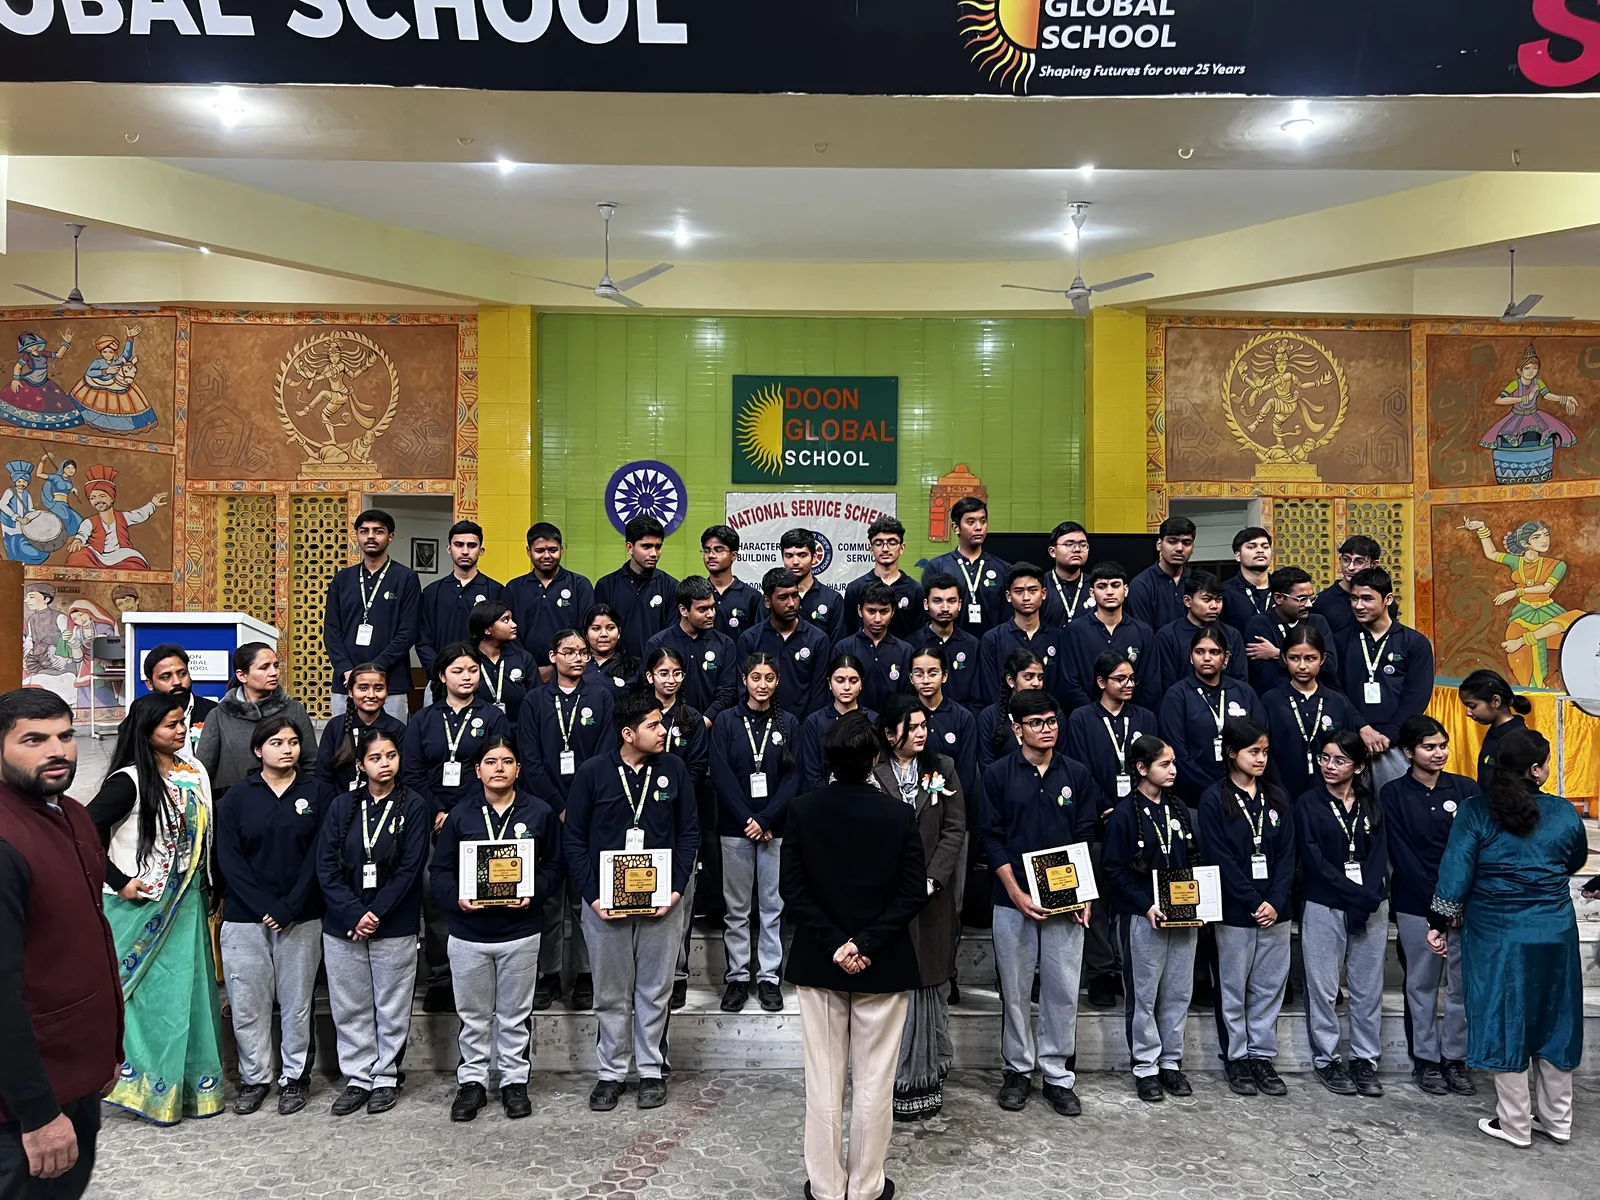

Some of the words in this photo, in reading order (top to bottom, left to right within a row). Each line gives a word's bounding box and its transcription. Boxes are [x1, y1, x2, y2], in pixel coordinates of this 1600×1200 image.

[1044, 0, 1176, 17] GLOBAL
[0, 0, 255, 36] OBAL
[1041, 24, 1177, 49] SCHOOL
[1517, 0, 1600, 88] S
[1039, 65, 1091, 80] Shaping
[1093, 65, 1141, 77] Futures
[1143, 63, 1163, 76] for
[1164, 66, 1194, 76] over
[1194, 63, 1211, 75] 25
[1212, 63, 1247, 75] Years
[785, 387, 859, 410] DOON
[785, 419, 895, 442] GLOBAL
[784, 450, 870, 467] SCHOOL
[727, 502, 788, 530] NATIONAL
[791, 500, 841, 518] SERVICE
[738, 542, 782, 551] HARACTER
[838, 543, 872, 552] COMMU
[737, 554, 777, 562] BUILDING
[846, 554, 876, 563] SERVIC
